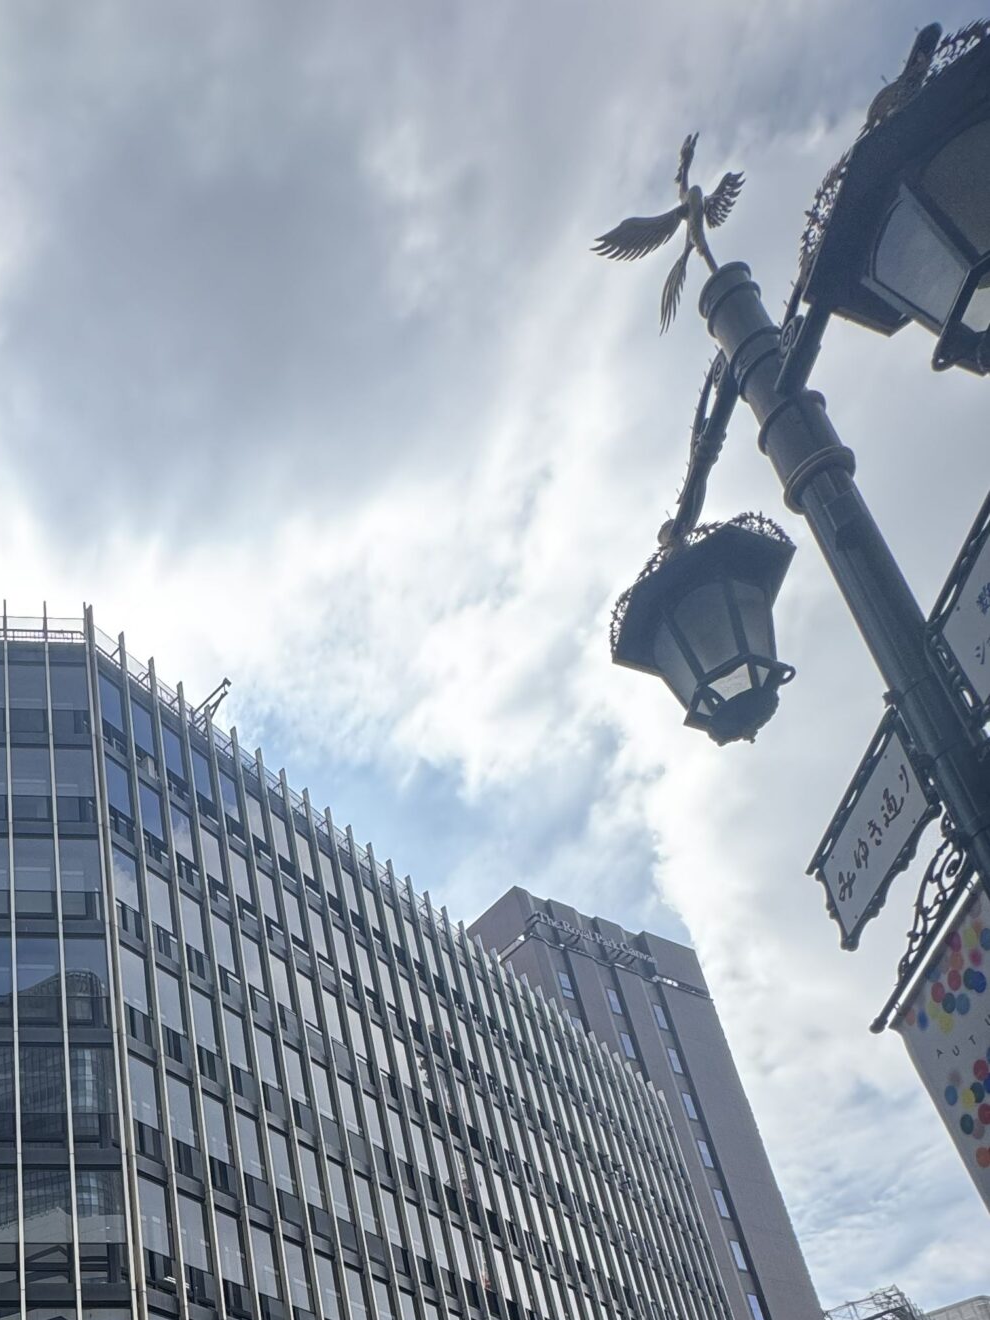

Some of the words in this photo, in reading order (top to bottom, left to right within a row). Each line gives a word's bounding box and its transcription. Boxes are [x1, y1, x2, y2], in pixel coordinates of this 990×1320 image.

[838, 764, 909, 902] みゆき通り
[562, 920, 593, 942] Royal
[593, 931, 621, 951] Park
[619, 942, 658, 964] Canvas
